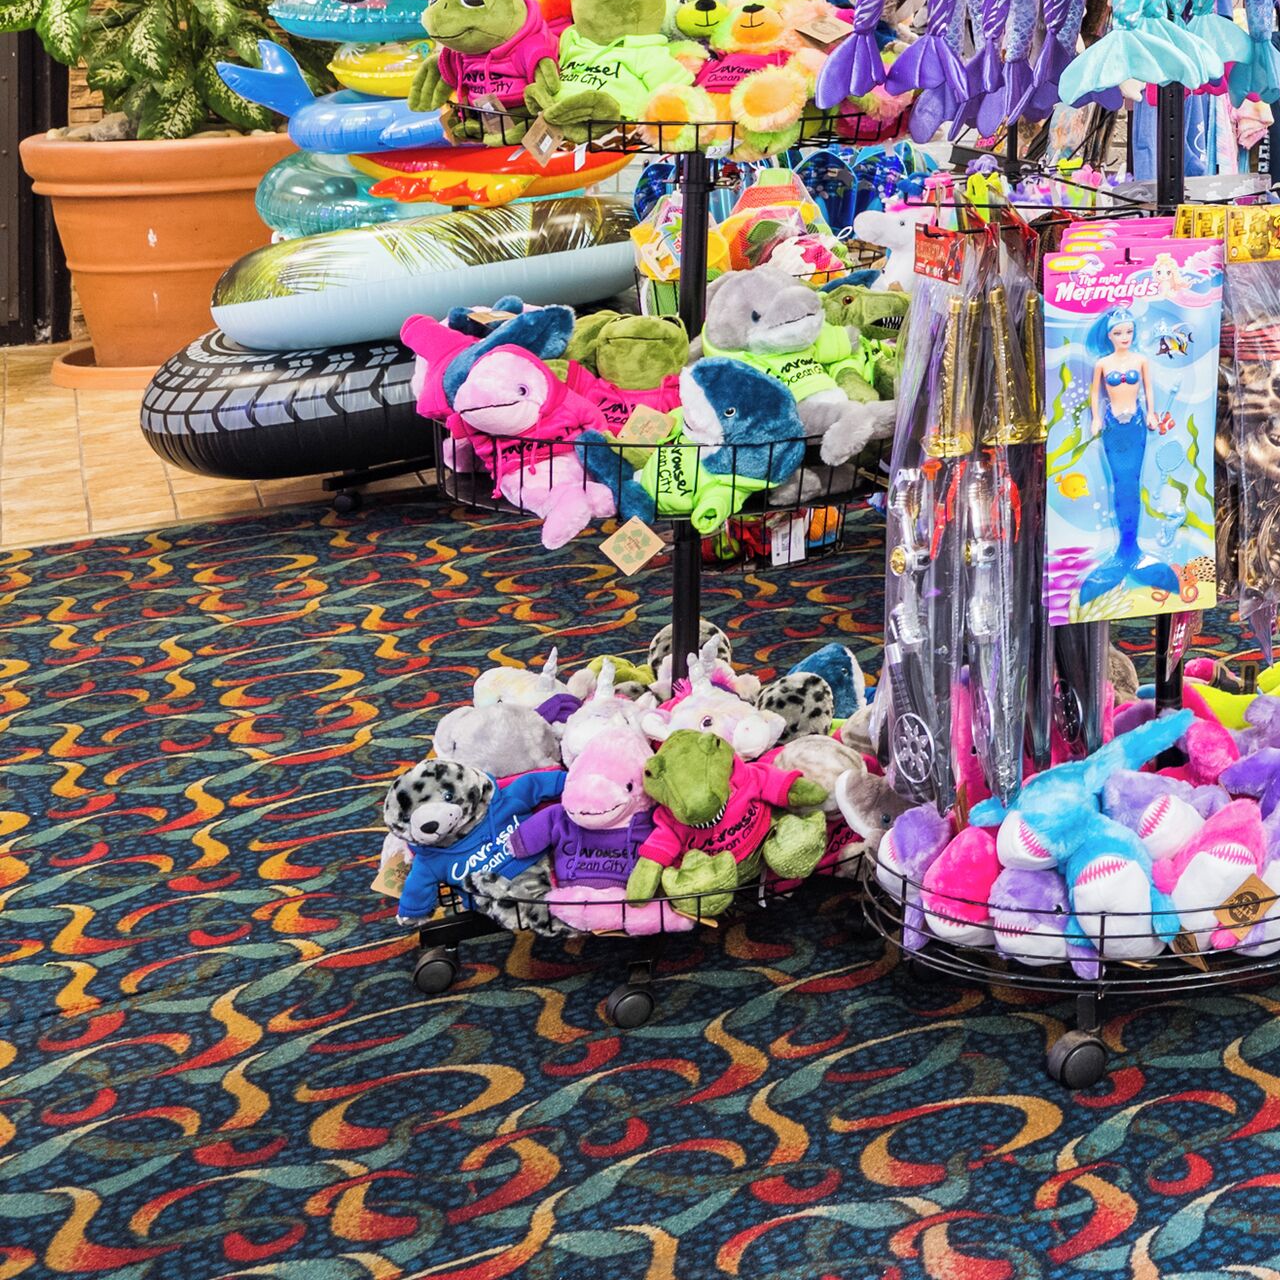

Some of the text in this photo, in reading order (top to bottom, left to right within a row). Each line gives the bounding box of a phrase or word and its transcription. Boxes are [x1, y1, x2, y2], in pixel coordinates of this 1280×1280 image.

[580, 73, 608, 91] City
[1077, 271, 1123, 285] The mini
[1054, 274, 1159, 306] Mermaids
[562, 839, 639, 860] Carousel
[602, 858, 628, 874] City
